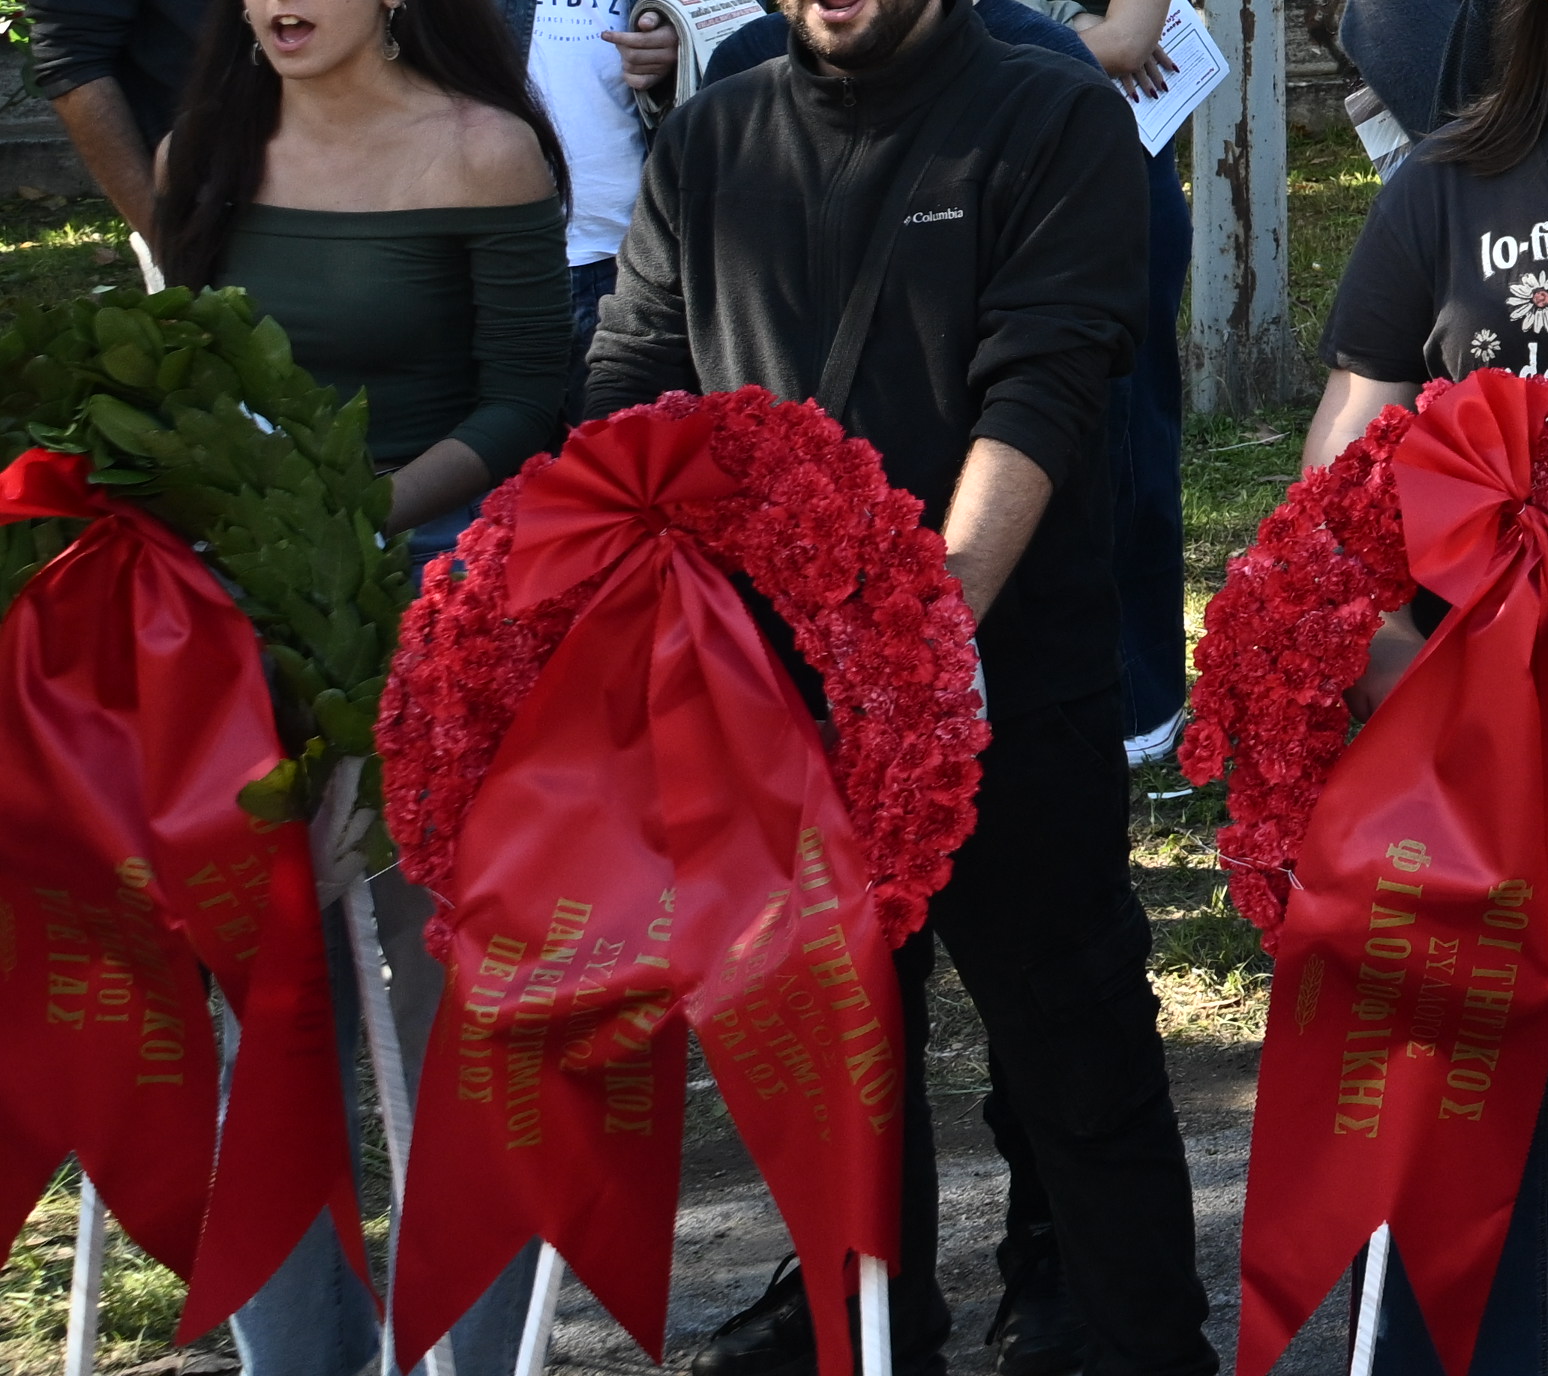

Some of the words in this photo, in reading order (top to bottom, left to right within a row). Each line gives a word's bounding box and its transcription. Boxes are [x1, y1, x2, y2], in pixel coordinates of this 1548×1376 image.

[913, 207, 963, 223] Columbia
[457, 934, 528, 1104] ΠΕΙΡΑΙΩΣ
[1333, 838, 1433, 1139] ΦΙΛΟΣΟΦΙΚΗΣ
[1406, 936, 1460, 1059] ΣΥΛΛΟΓΟΣ
[1438, 879, 1534, 1122] ΦΟΙΤΗΤΙΚΟΣ
